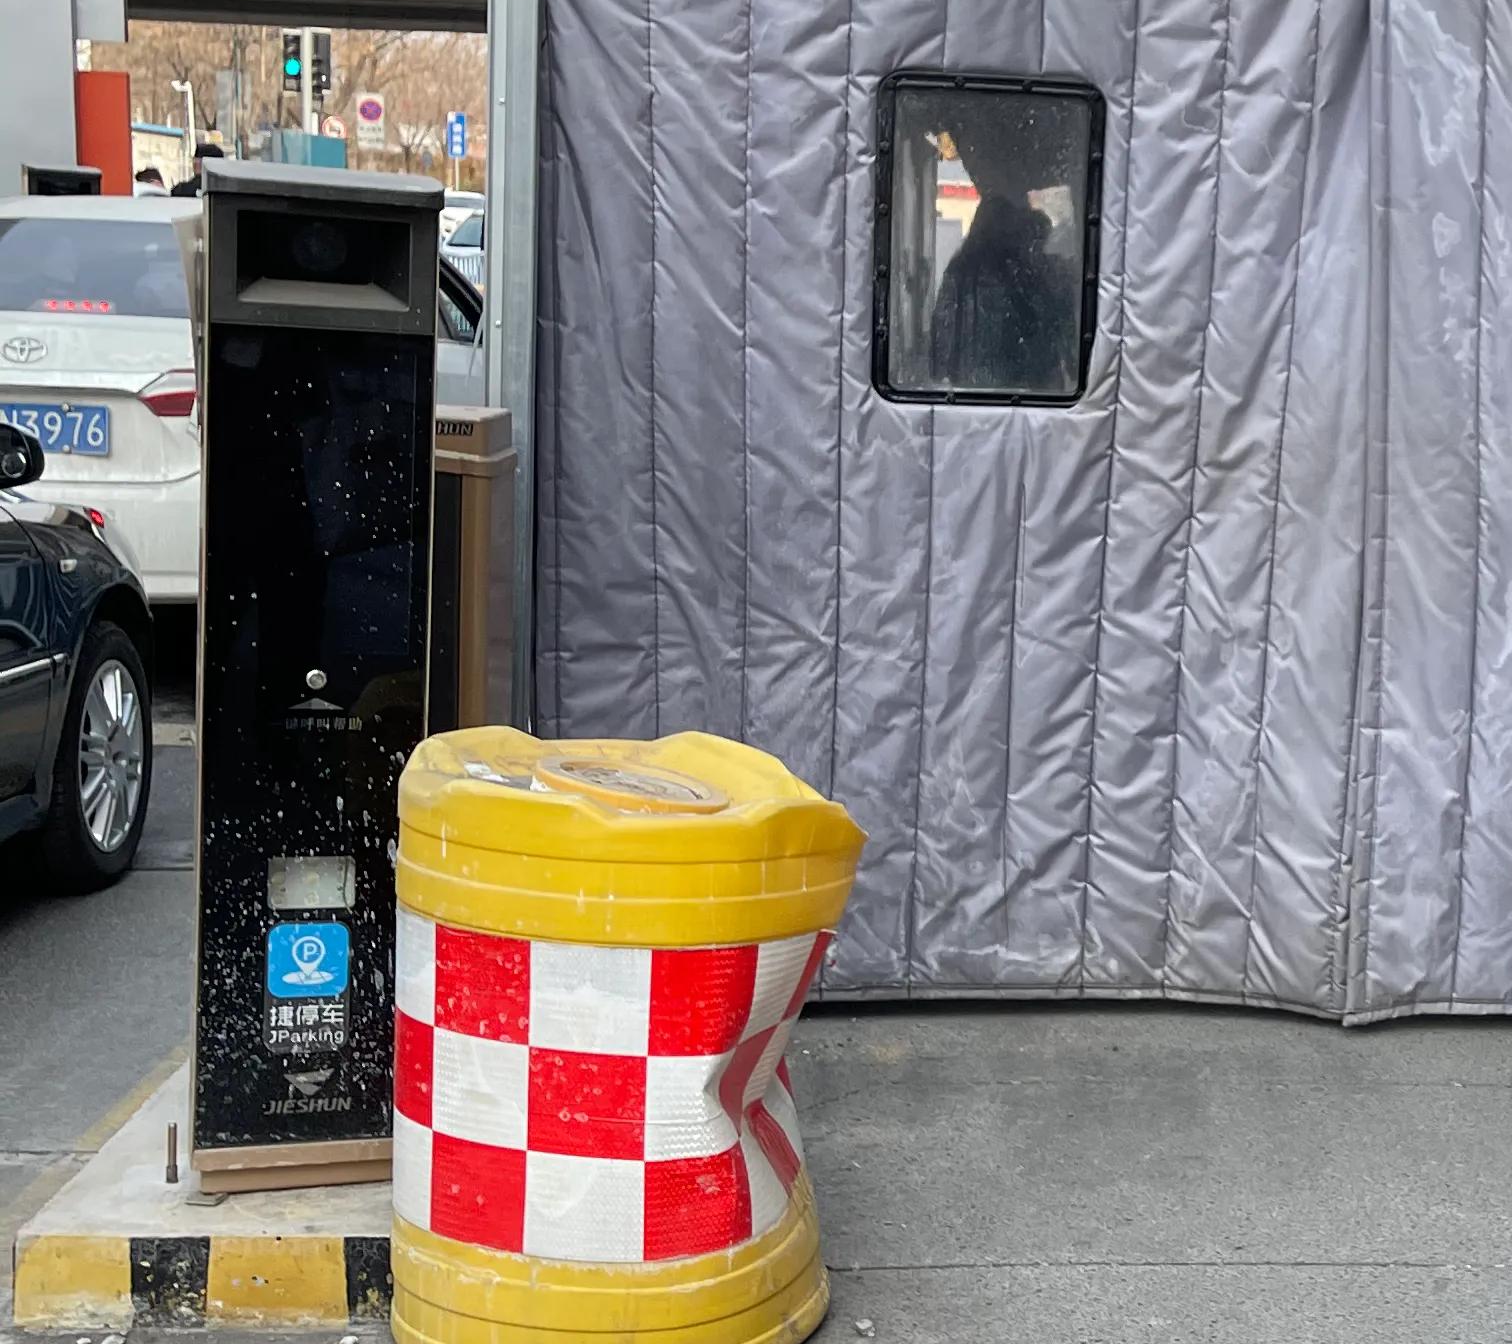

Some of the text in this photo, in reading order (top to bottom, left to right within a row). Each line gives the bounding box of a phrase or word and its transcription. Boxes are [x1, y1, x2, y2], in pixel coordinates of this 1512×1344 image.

[303, 942, 318, 961] P
[270, 1002, 344, 1027] 捷停车
[269, 1028, 344, 1045] JParking
[263, 1097, 352, 1115] JIESHUN
